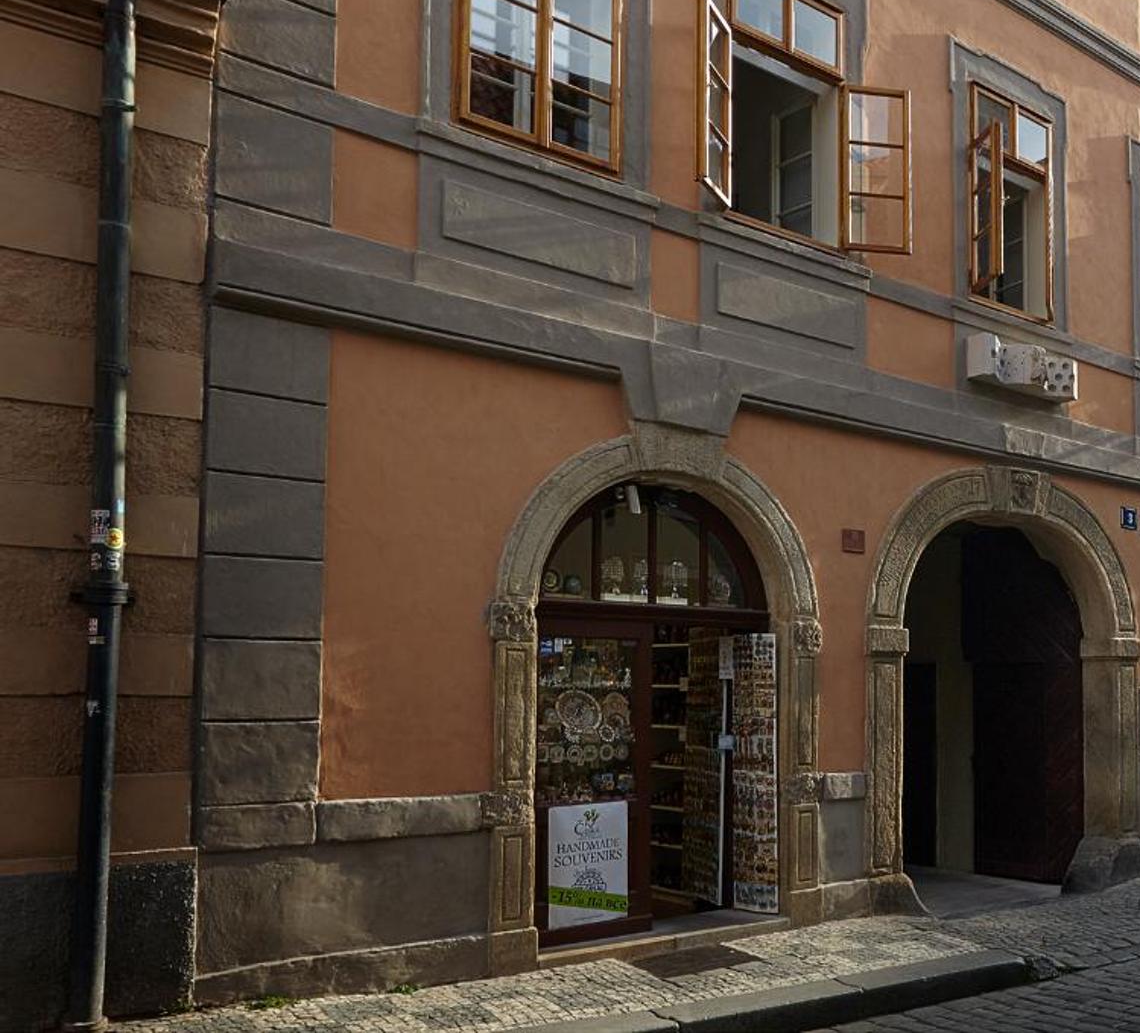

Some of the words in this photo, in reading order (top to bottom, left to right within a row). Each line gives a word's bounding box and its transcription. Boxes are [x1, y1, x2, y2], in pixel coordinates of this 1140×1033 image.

[1127, 512, 1133, 524] 3
[557, 838, 619, 854] HANDMADE
[553, 848, 623, 867] SOUVENIRS
